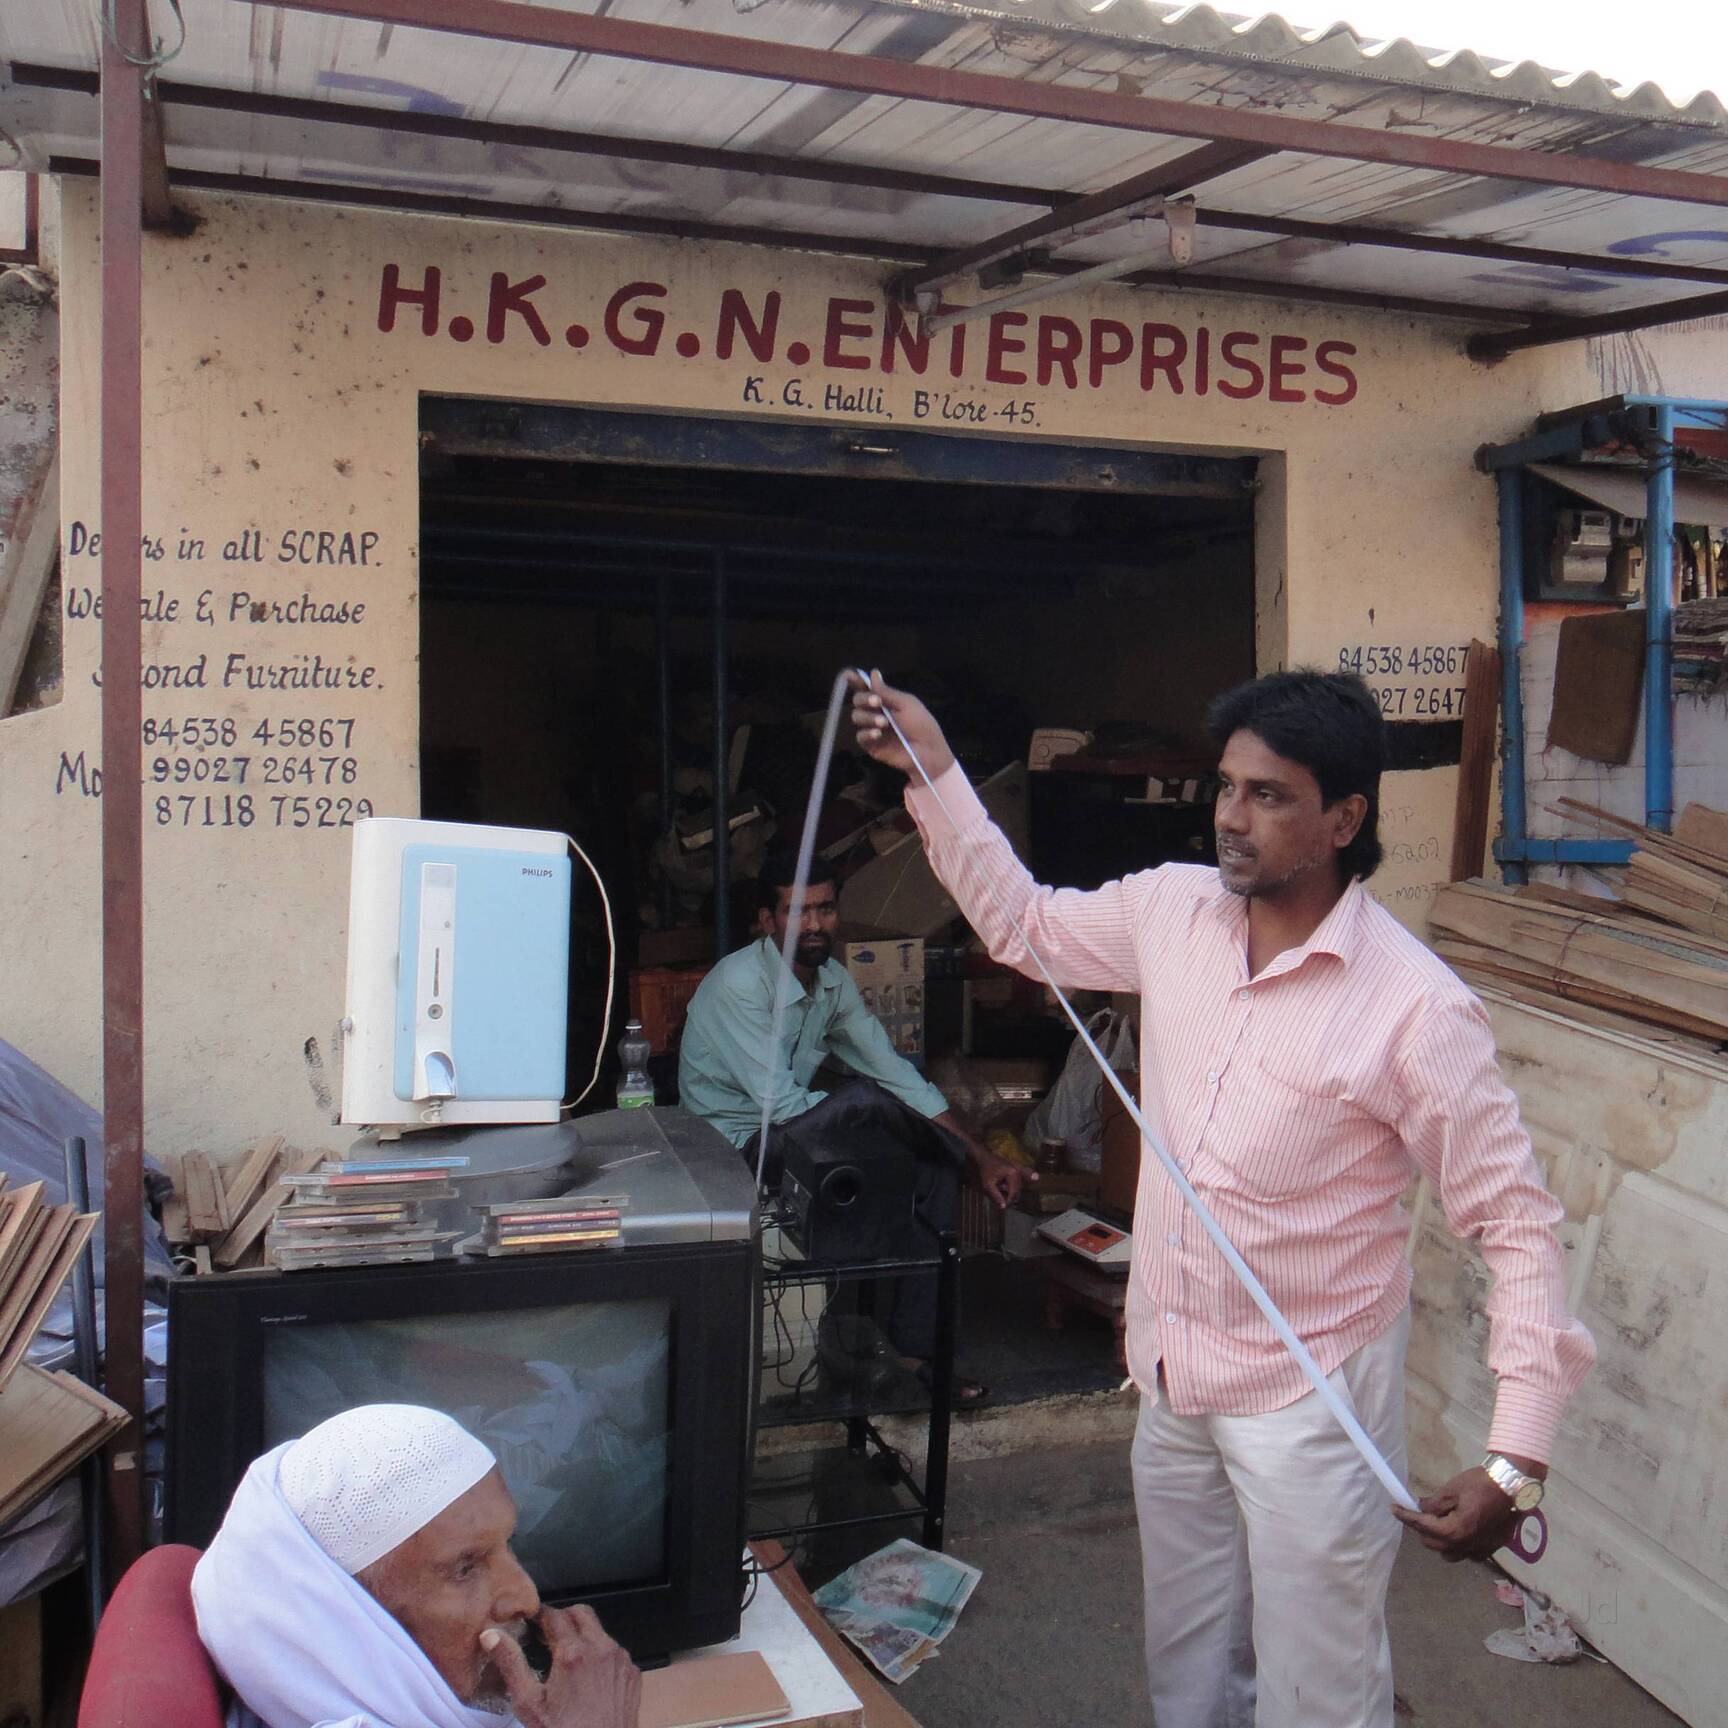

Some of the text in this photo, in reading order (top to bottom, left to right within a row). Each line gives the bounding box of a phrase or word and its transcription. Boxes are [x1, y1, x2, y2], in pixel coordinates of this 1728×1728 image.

[824, 384, 892, 421] Halli,
[69, 521, 383, 566] Ders in all SCRAP.
[140, 590, 179, 622] ale
[229, 591, 366, 624] Purchase
[222, 654, 385, 690] Furniture.
[1339, 646, 1470, 675] 84538 45867
[1414, 687, 1467, 716] 2647
[143, 718, 355, 749] 84538 45867
[153, 757, 251, 784] 99027
[262, 757, 358, 784] 26478
[155, 795, 374, 828] 87118 75229
[521, 867, 553, 878] PHILIPS
